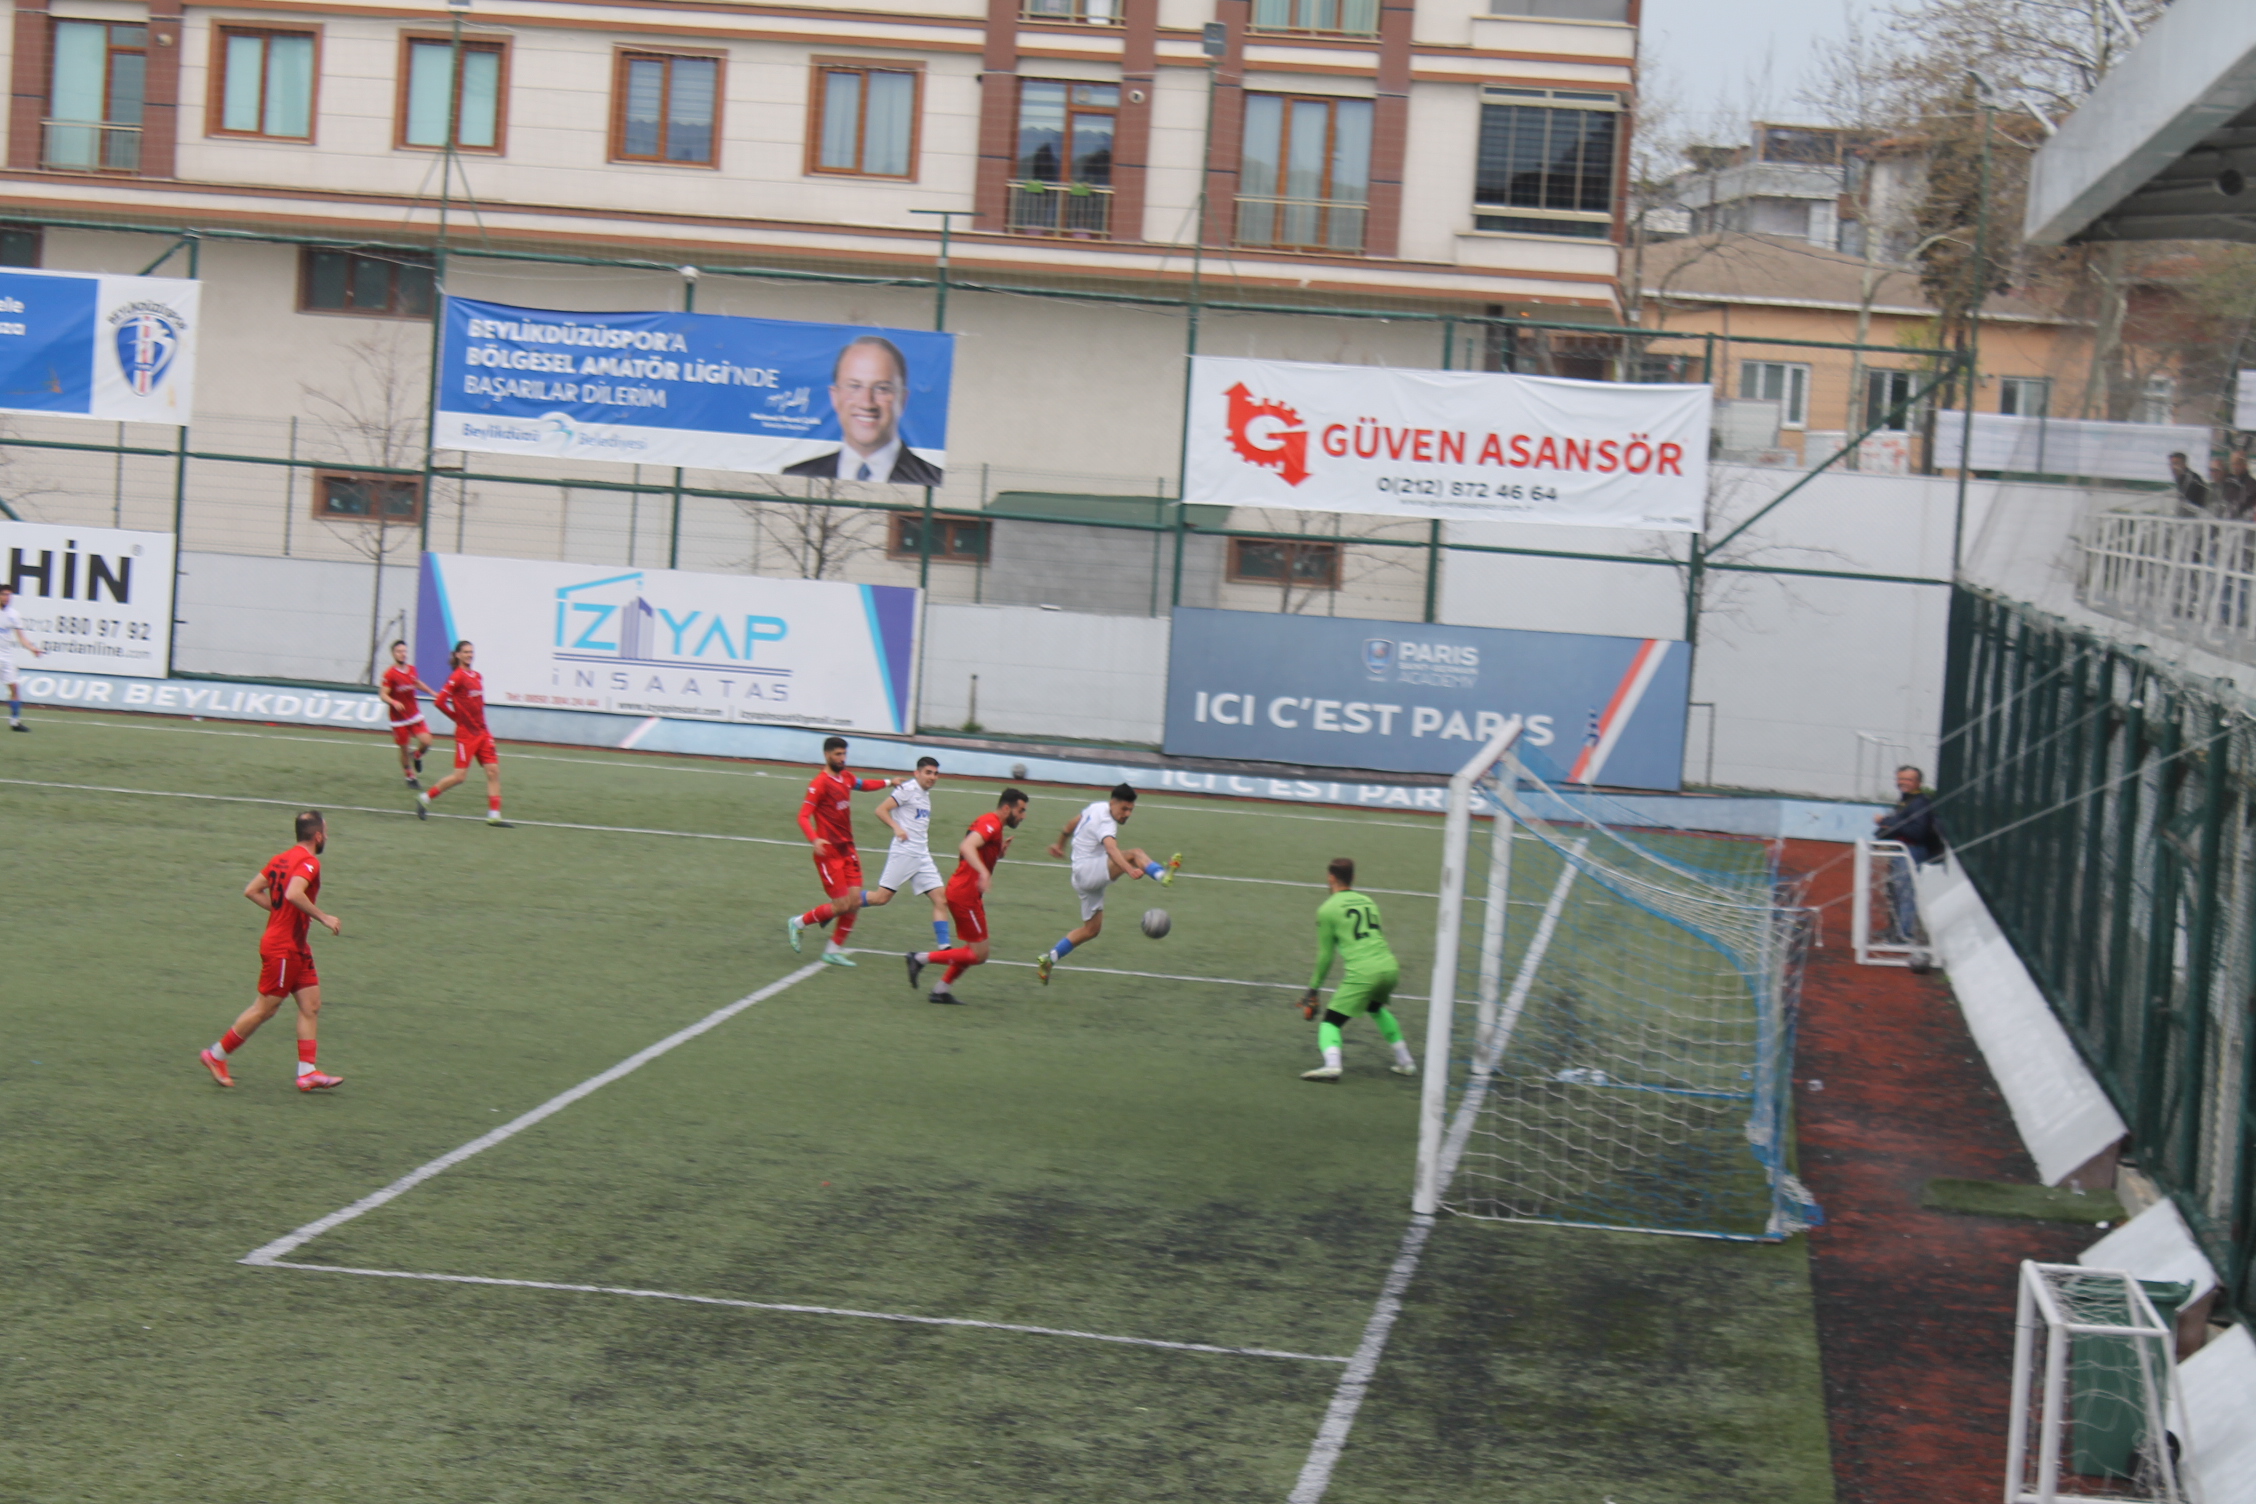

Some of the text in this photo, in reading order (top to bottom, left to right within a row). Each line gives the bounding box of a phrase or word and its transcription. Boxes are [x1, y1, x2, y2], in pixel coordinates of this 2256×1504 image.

[466, 343, 577, 374] BÖLGESEL
[579, 355, 681, 382] AMATÖR
[464, 374, 667, 409] BAŞARILAR DİLERİM
[1321, 417, 1684, 477] GÜVEN ASANSÖR
[1377, 476, 1558, 501] 0(212) 872 46 64
[55, 615, 91, 636] 880
[97, 619, 122, 638] 97
[127, 622, 152, 641] 92
[1398, 641, 1480, 666] PARIS
[1194, 691, 1255, 726] ICI
[1267, 697, 1402, 736] C'EST
[1229, 774, 1341, 800] CEST
[1360, 785, 1488, 813] PARS
[1347, 907, 1379, 940] 24
